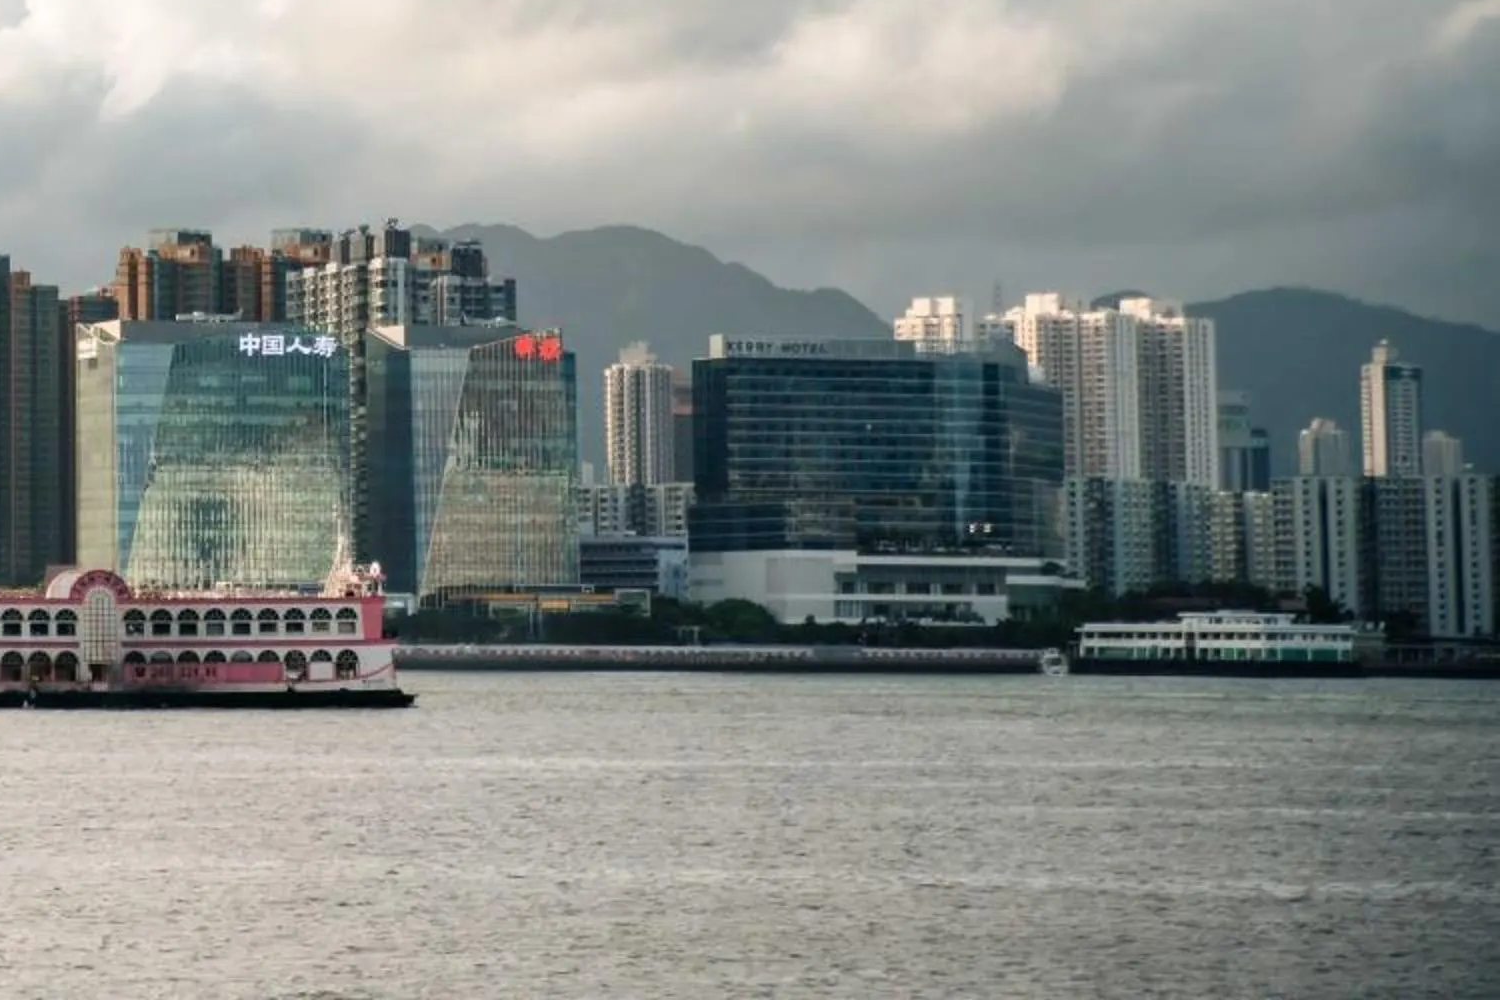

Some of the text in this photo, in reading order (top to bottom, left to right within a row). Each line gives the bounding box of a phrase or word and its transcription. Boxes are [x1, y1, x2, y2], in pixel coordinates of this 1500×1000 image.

[240, 333, 337, 357] 中国人寿
[781, 342, 829, 354] HOTEL
